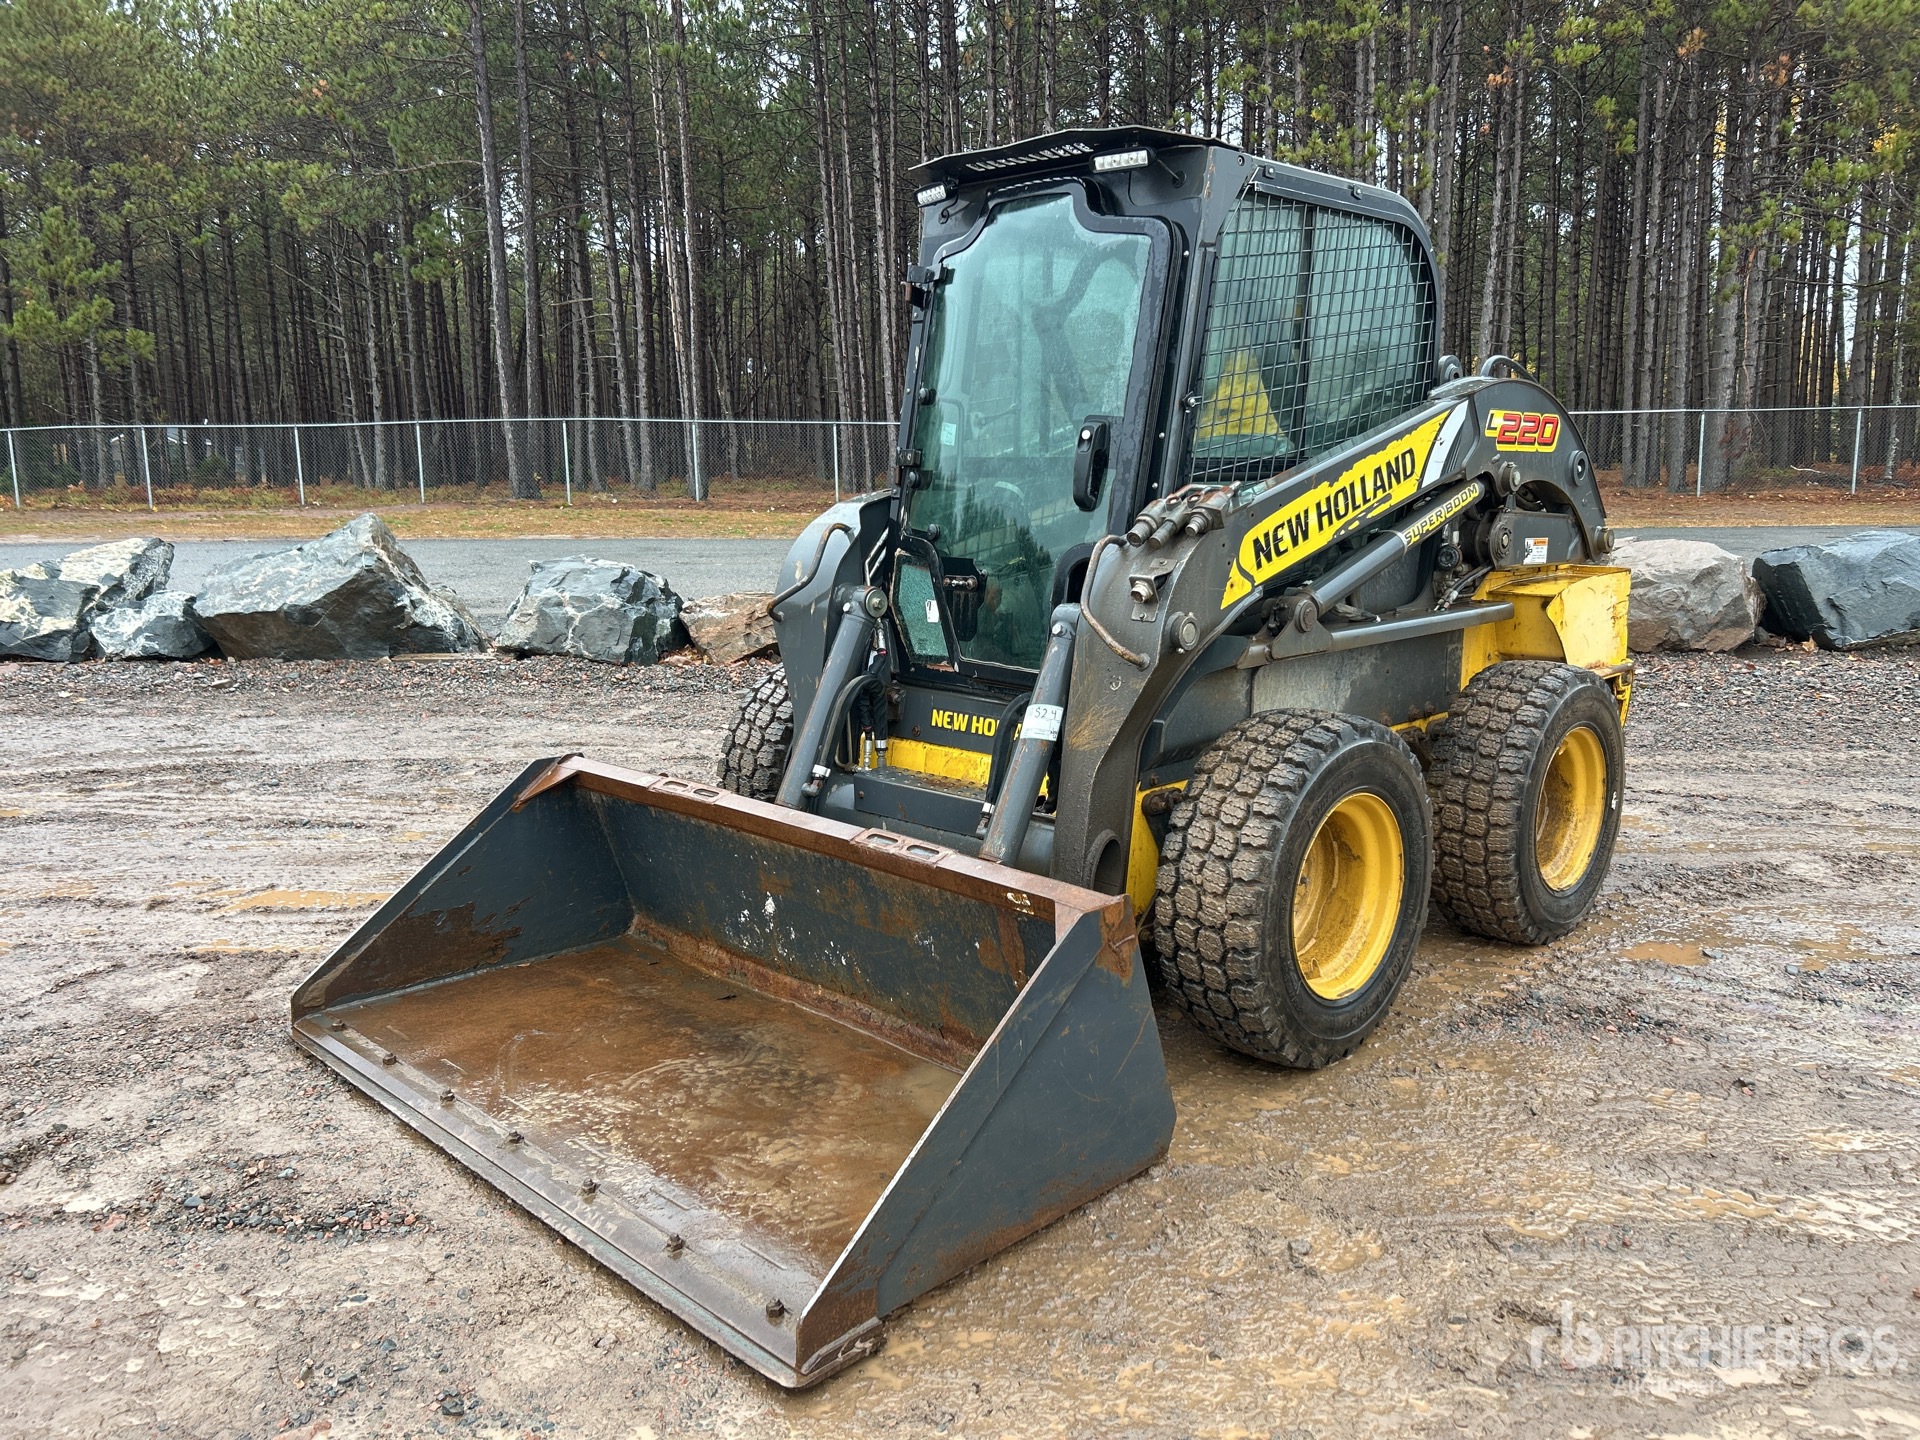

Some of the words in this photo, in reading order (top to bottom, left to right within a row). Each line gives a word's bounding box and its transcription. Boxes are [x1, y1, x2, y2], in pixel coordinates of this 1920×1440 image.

[1486, 412, 1559, 447] L220
[1252, 506, 1310, 571] NEW
[1315, 447, 1416, 534] HOLLAND
[1403, 507, 1444, 544] SUPER
[1444, 484, 1479, 515] BOOM
[931, 708, 969, 732] NEW
